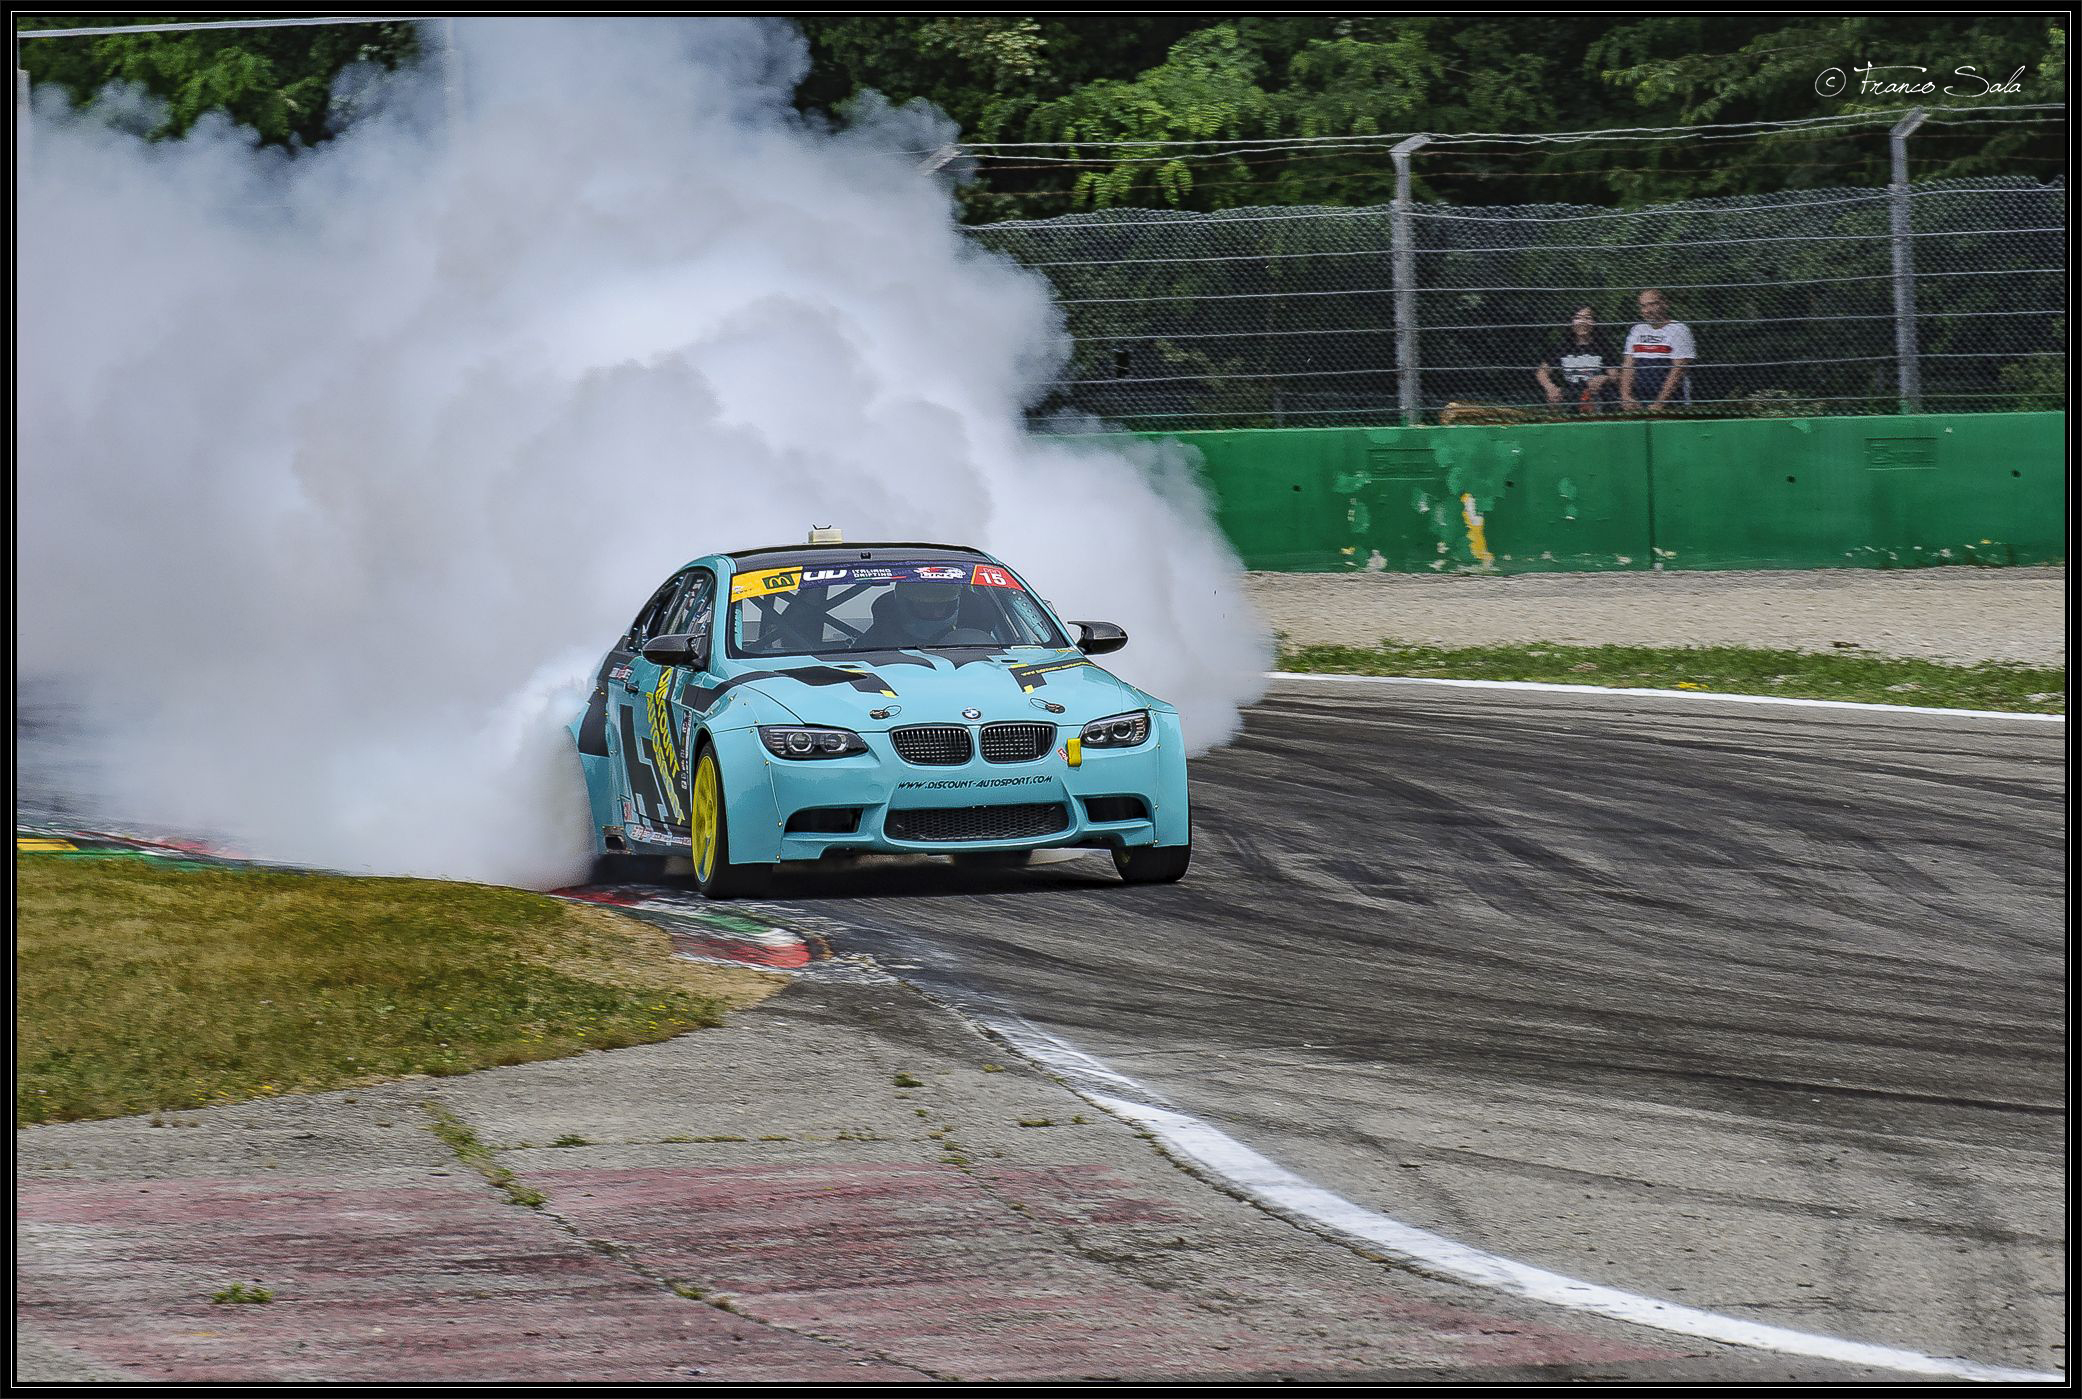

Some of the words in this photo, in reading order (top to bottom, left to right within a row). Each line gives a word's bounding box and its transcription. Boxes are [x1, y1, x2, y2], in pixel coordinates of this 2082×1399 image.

[979, 572, 1007, 585] 15
[655, 667, 681, 779] DISCOUNT
[898, 775, 1053, 790] WWW.DISCOUNT-AUTOSPORT.COM
